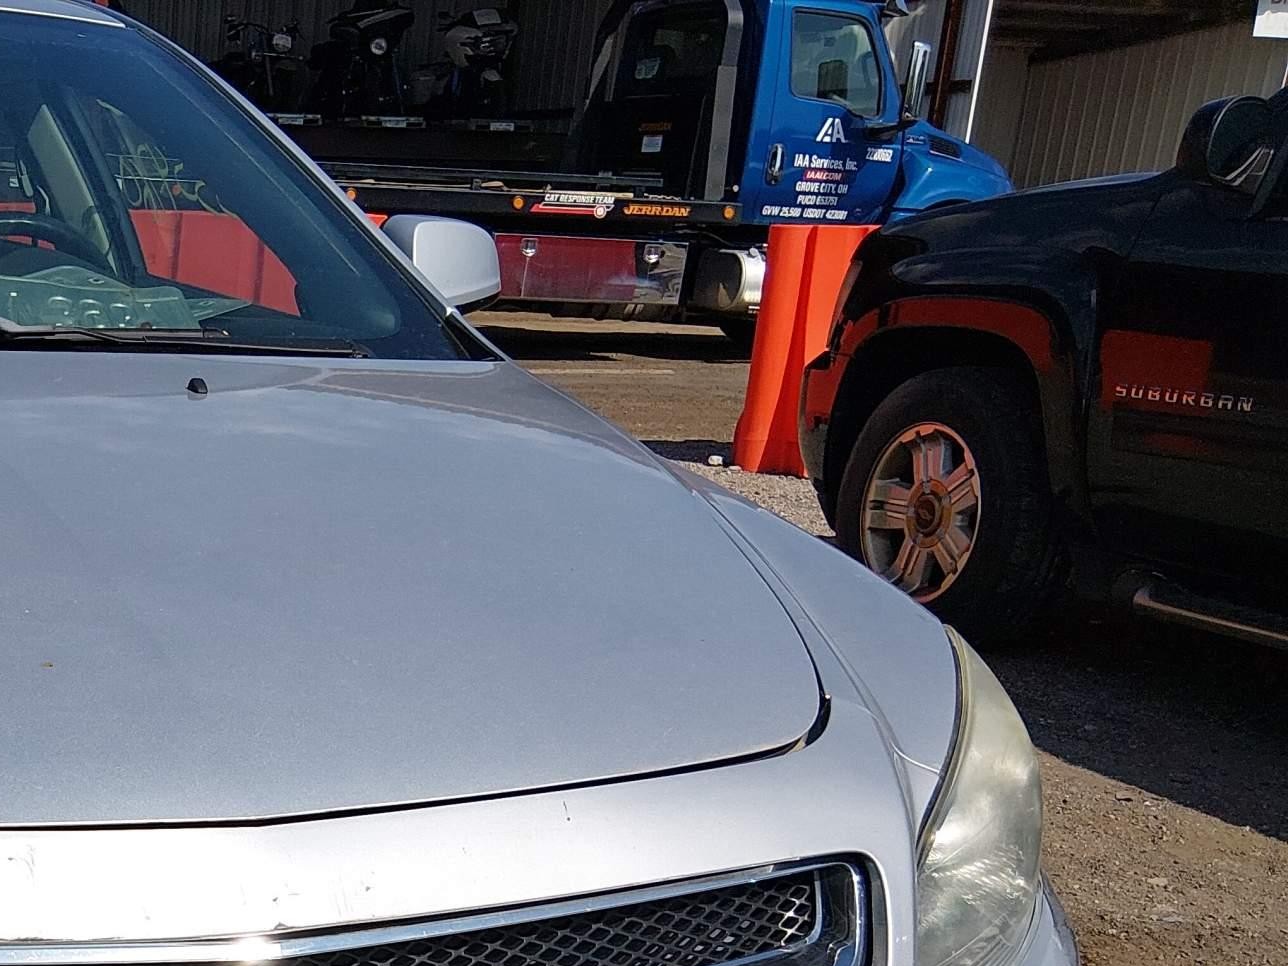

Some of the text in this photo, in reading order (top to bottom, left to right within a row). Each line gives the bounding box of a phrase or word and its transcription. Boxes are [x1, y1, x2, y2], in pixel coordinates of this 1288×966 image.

[794, 153, 858, 171] IAA Services, Inc.
[795, 181, 820, 193] GROVE
[837, 184, 848, 194] OH
[544, 193, 615, 205] CAT RESPONSE TEAM
[762, 205, 781, 216] GVW
[803, 207, 826, 219] USDOT
[1115, 384, 1253, 412] SUBURBAN
